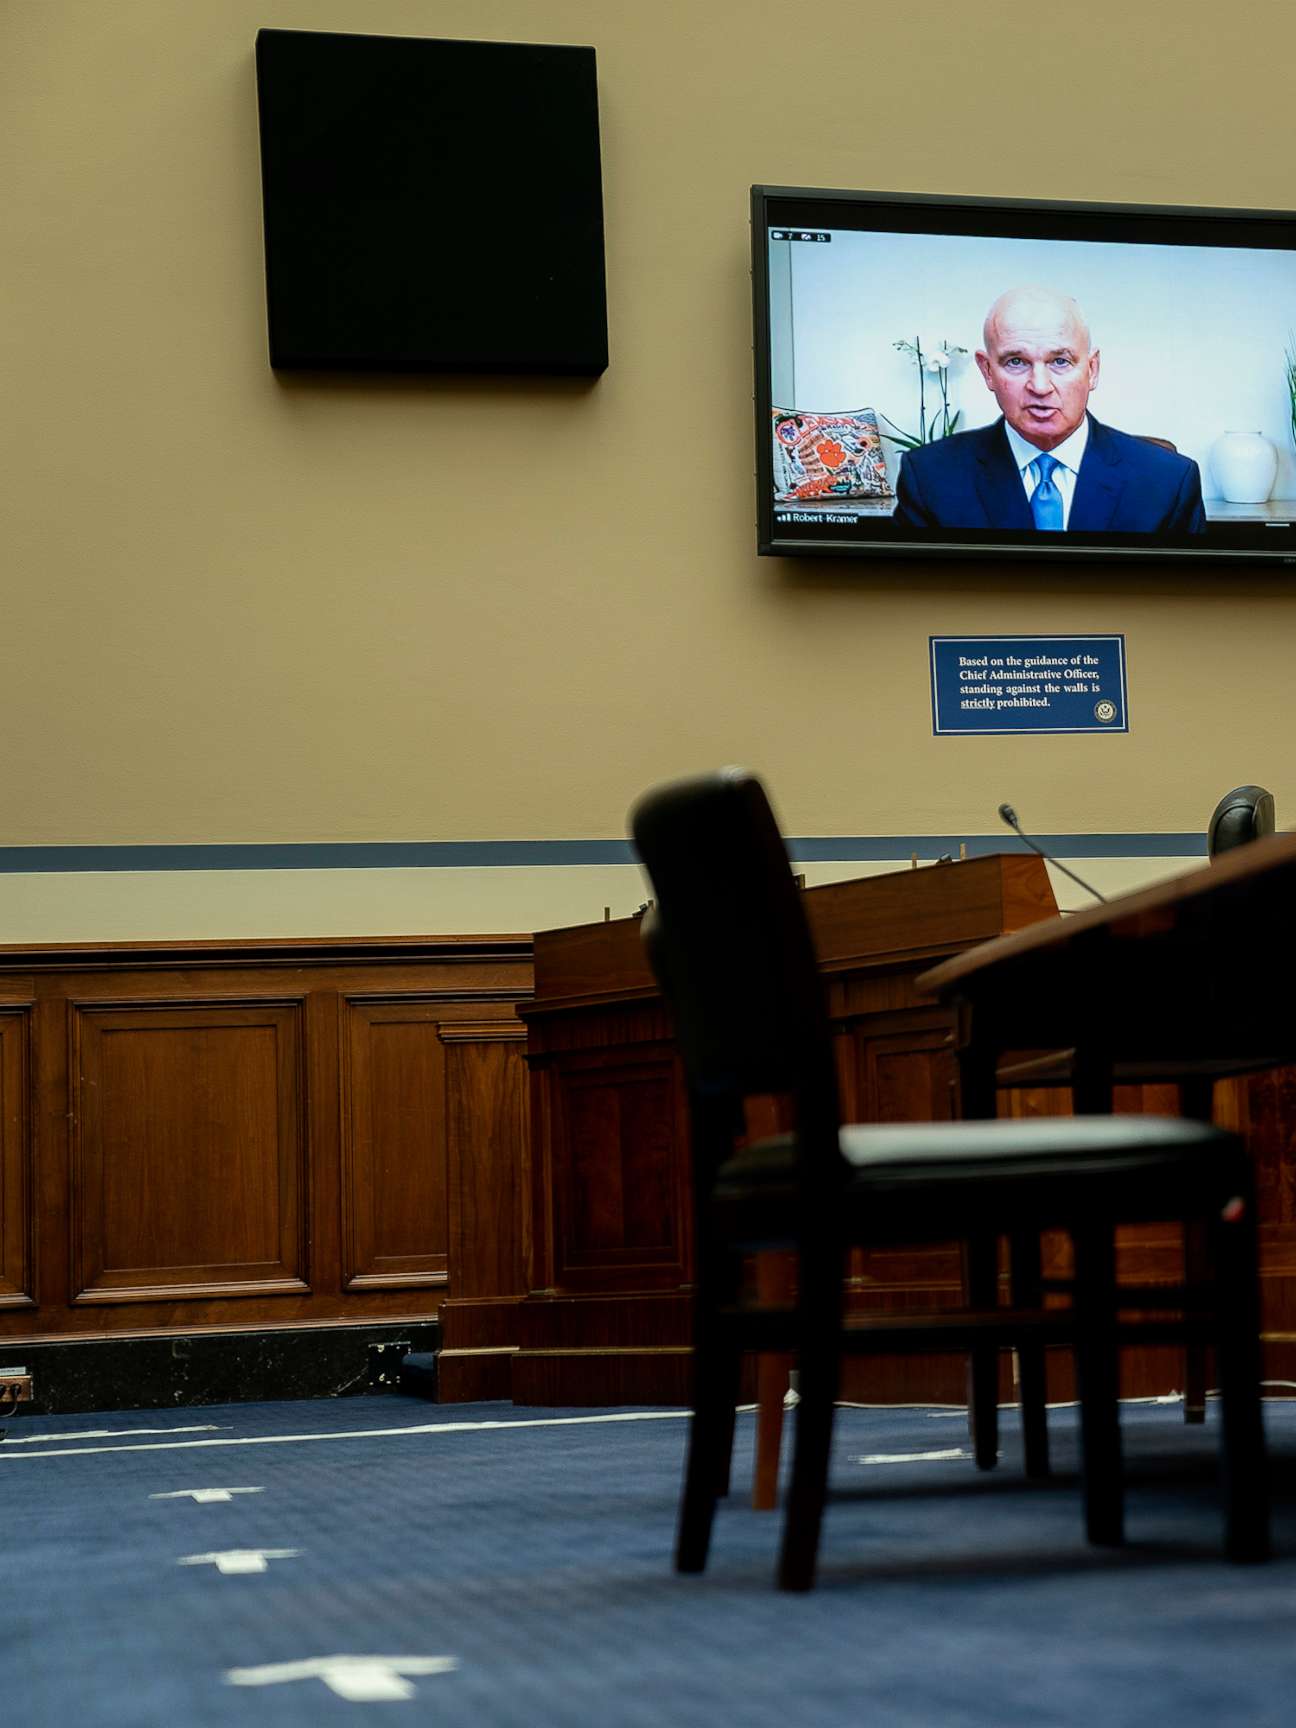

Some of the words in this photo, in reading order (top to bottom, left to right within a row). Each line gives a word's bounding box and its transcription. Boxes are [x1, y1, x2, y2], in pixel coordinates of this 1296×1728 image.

[792, 513, 823, 522] Robert
[826, 514, 858, 523] Kramer
[959, 657, 988, 666] Based
[991, 658, 1003, 666] on
[1006, 656, 1022, 665] the
[1024, 656, 1067, 667] guidance
[1070, 655, 1081, 665] of
[1083, 655, 1099, 664] the
[959, 671, 987, 680] Chief
[990, 670, 1062, 680] Administrative
[1064, 669, 1100, 680] Officer,
[960, 684, 1002, 695] standing
[1006, 684, 1041, 695] against
[1045, 684, 1060, 693] the
[1064, 683, 1088, 692] walls
[1092, 683, 1100, 692] is
[960, 699, 995, 710] strictly
[997, 697, 1050, 709] prohibited.
